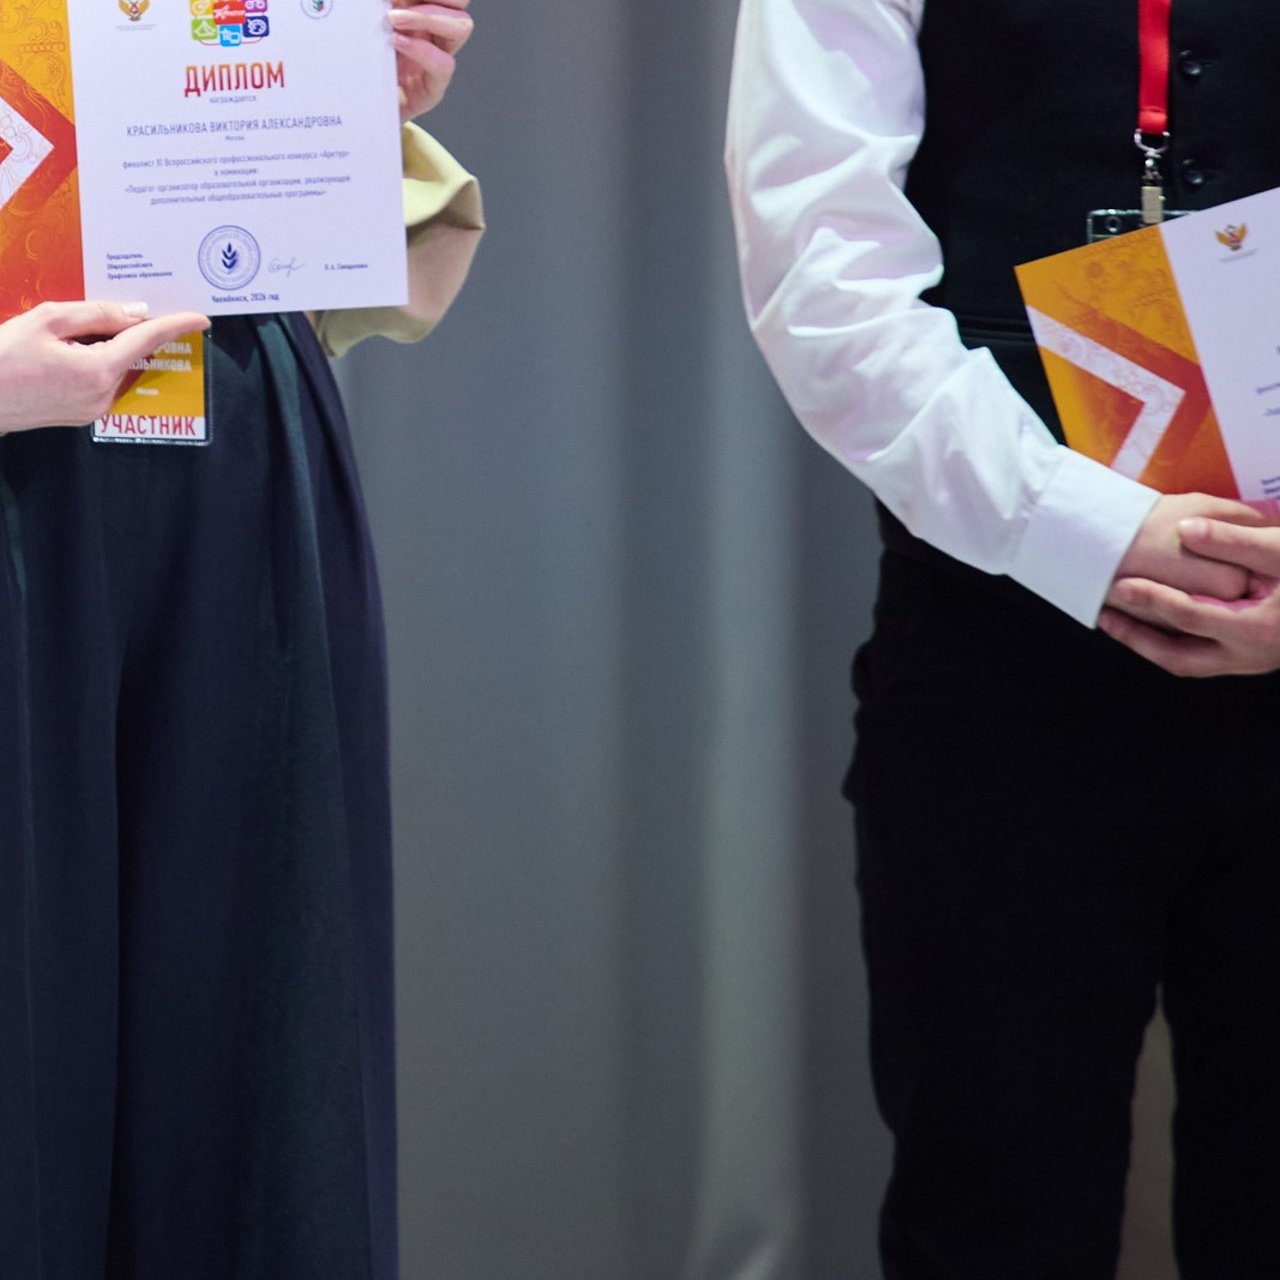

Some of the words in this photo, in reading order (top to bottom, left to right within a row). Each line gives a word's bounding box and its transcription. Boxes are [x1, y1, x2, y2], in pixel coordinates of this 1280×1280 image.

[184, 61, 285, 98] ДИПЛОМ
[126, 122, 208, 136] КРАСИЛЬНИКОВА
[209, 119, 259, 132] ВИКТОРИЯ
[261, 115, 342, 129] АЛЕКСАНДРОВНА
[101, 414, 196, 436] УЧАСТНИК
